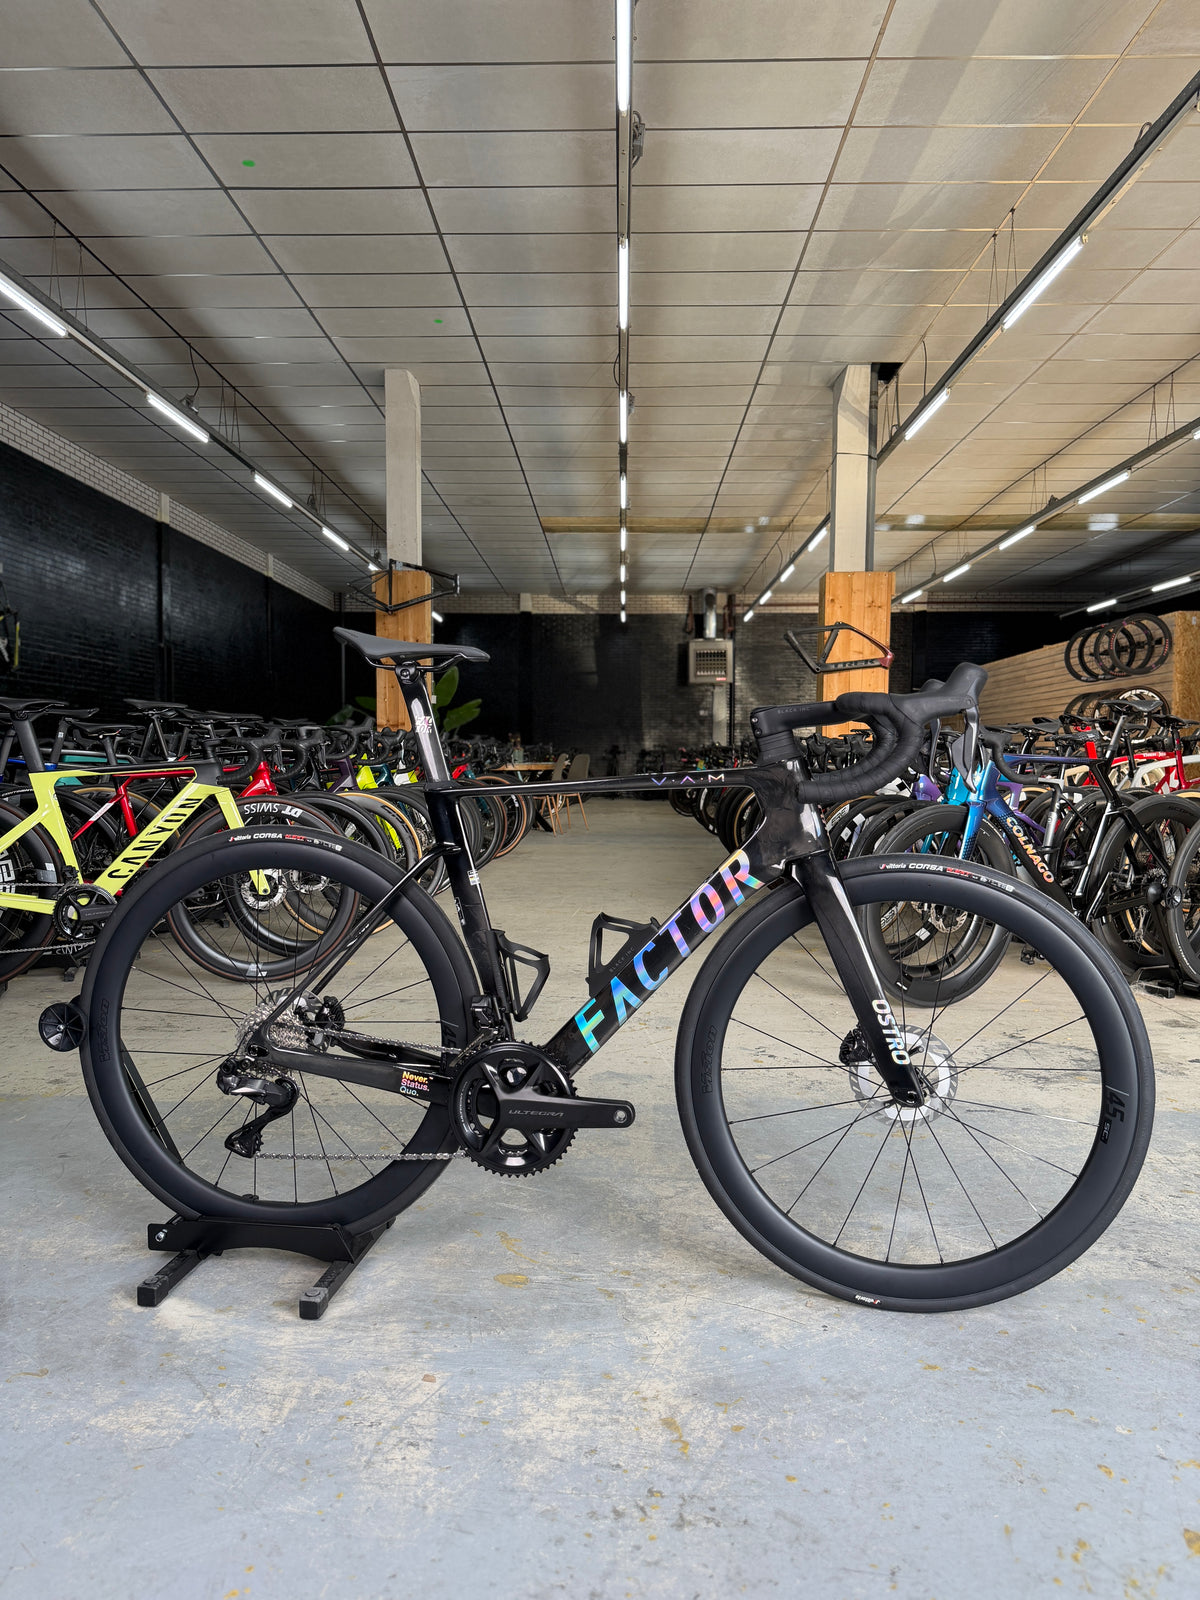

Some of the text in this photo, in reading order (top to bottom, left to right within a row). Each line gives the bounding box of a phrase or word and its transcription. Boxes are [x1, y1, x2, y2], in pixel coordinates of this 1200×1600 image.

[834, 660, 875, 668] TREK
[243, 802, 303, 818] DT SWISS
[107, 798, 203, 879] CANYON
[1006, 816, 1055, 883] COLNAGO
[908, 862, 944, 872] CORSA
[575, 849, 765, 1053] FACTOR
[872, 999, 911, 1065] OSTRO
[399, 1086, 419, 1097] Quo.
[401, 1078, 430, 1091] Status.
[508, 1109, 564, 1117] ULTEGRA
[1105, 1092, 1126, 1122] 45
